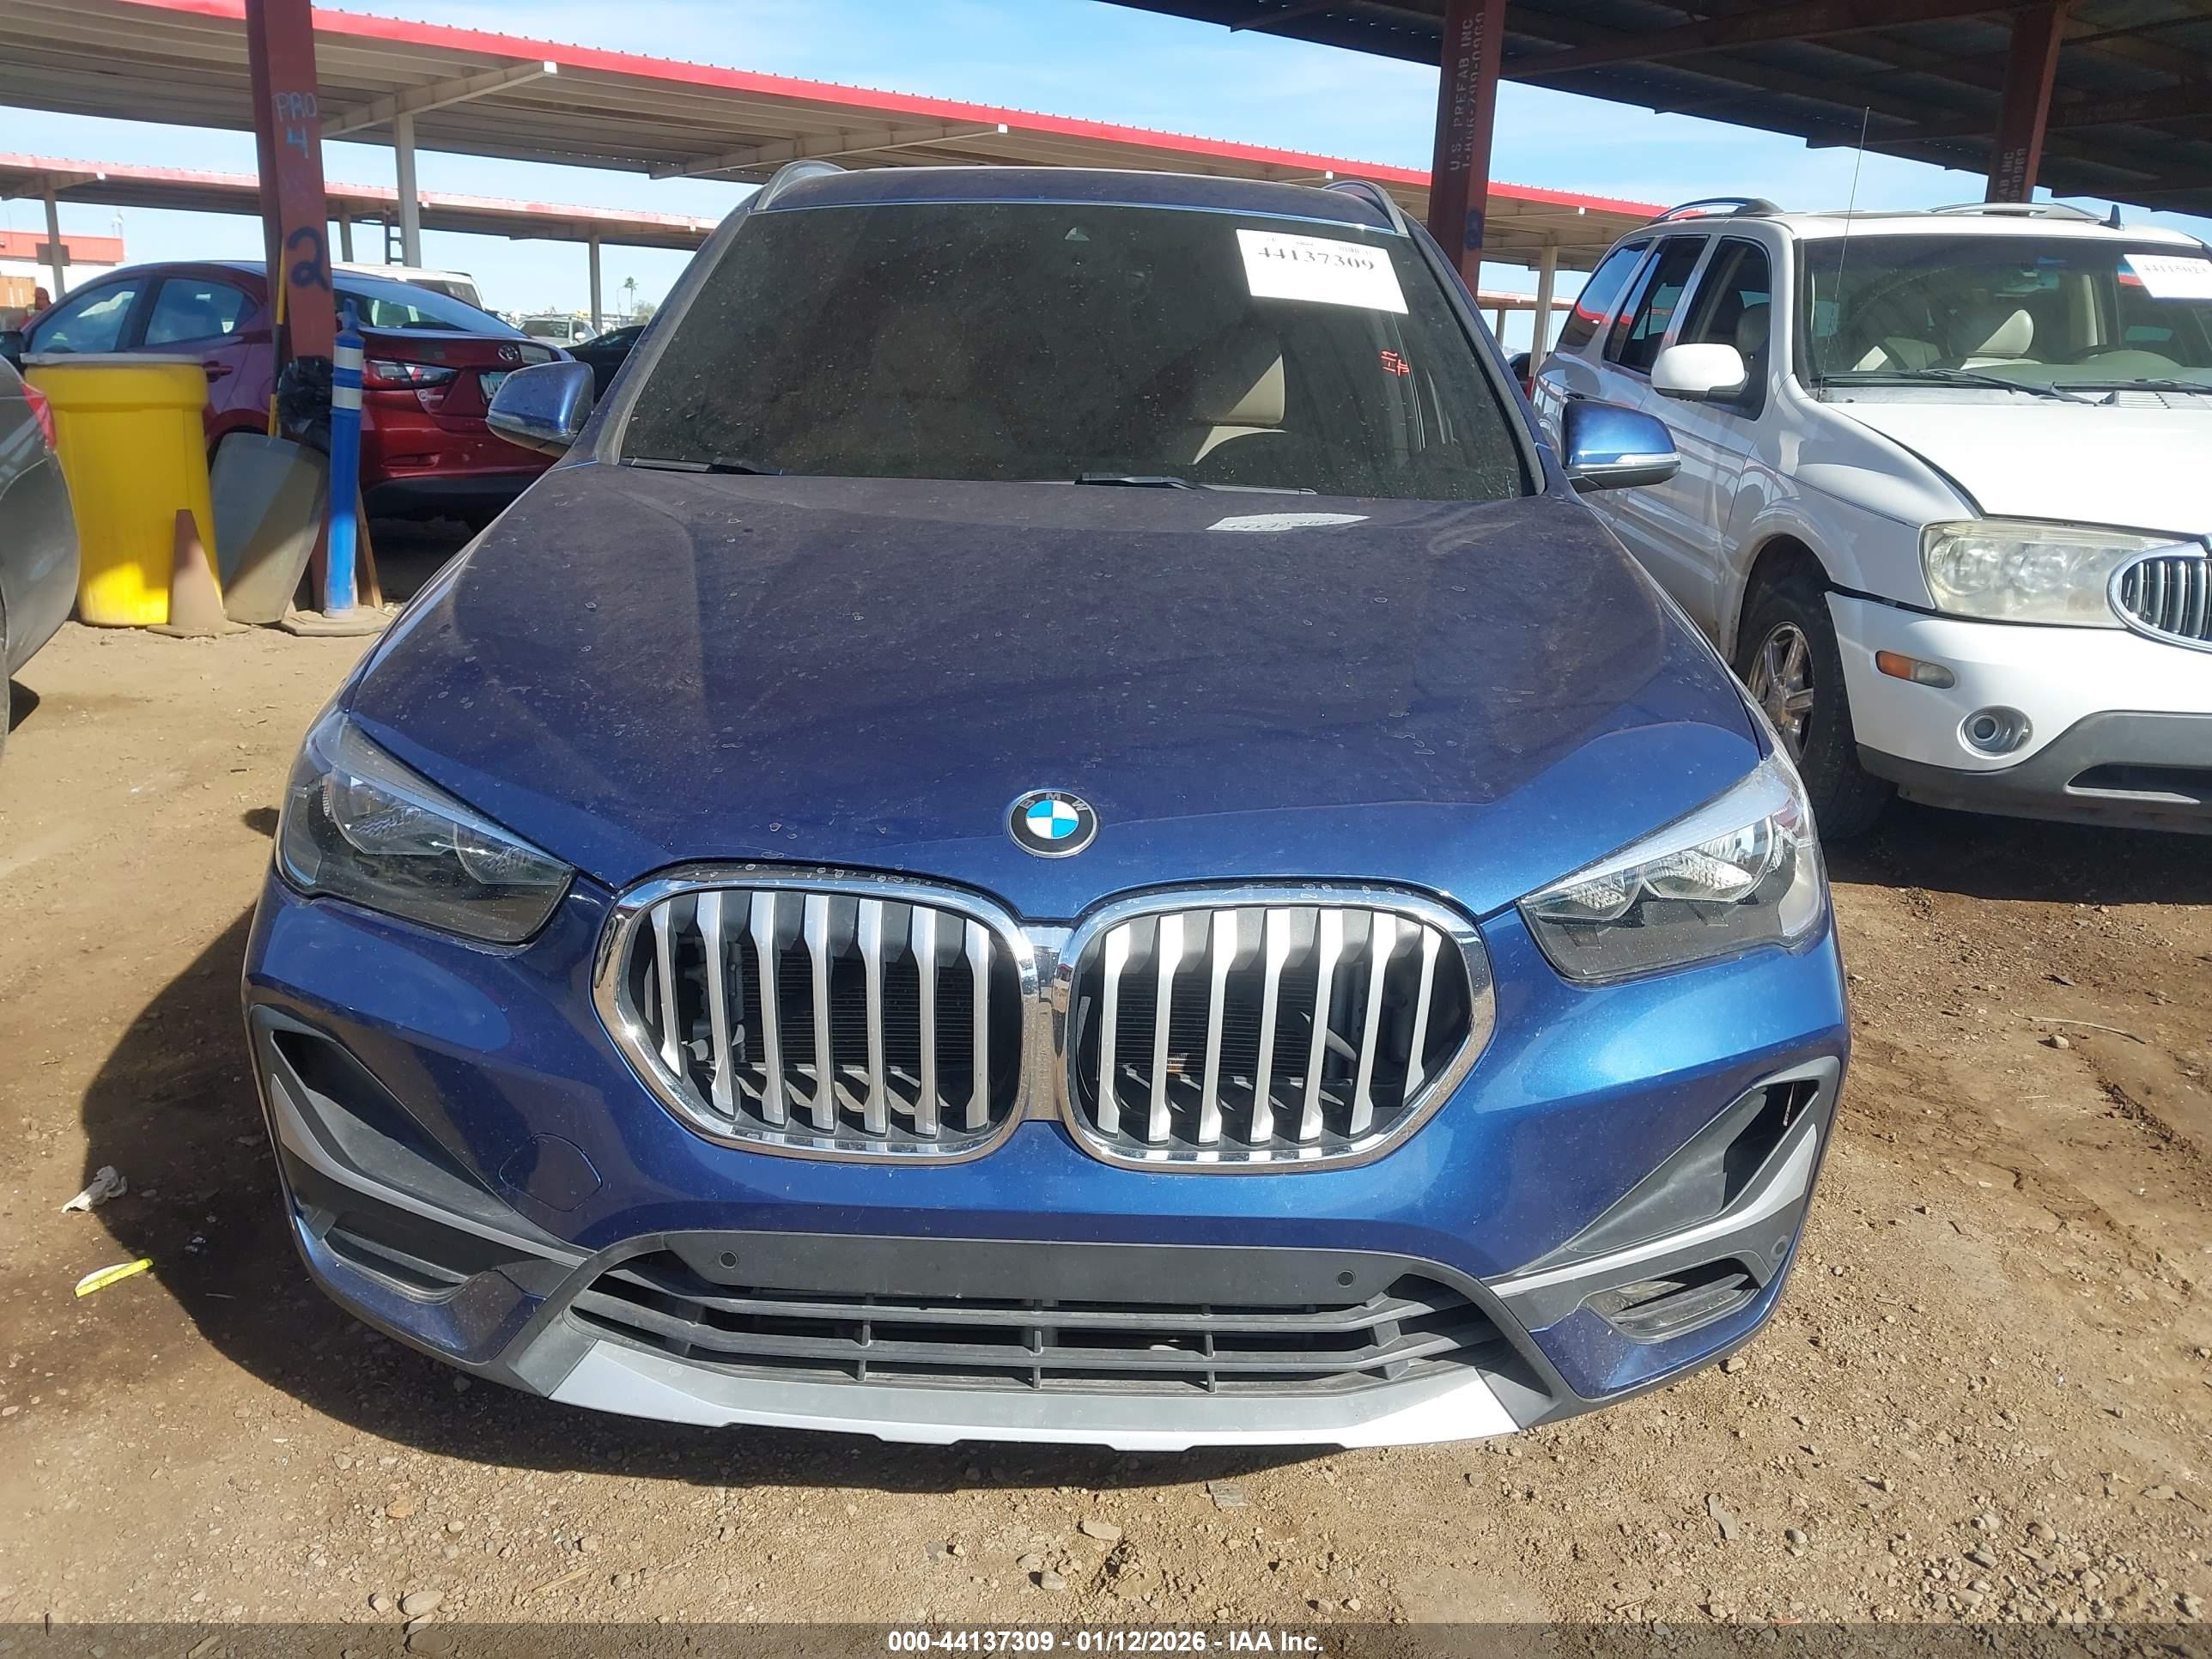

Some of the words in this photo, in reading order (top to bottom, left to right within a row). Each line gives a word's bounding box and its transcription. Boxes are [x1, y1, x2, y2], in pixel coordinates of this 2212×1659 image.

[1461, 19, 1474, 48] INC
[1453, 57, 1470, 128] PREFAB
[286, 124, 310, 160] 4
[1449, 137, 1463, 171] U.S.
[288, 226, 331, 292] 2
[1258, 246, 1375, 270] 44137309
[1019, 793, 1089, 811] BMW
